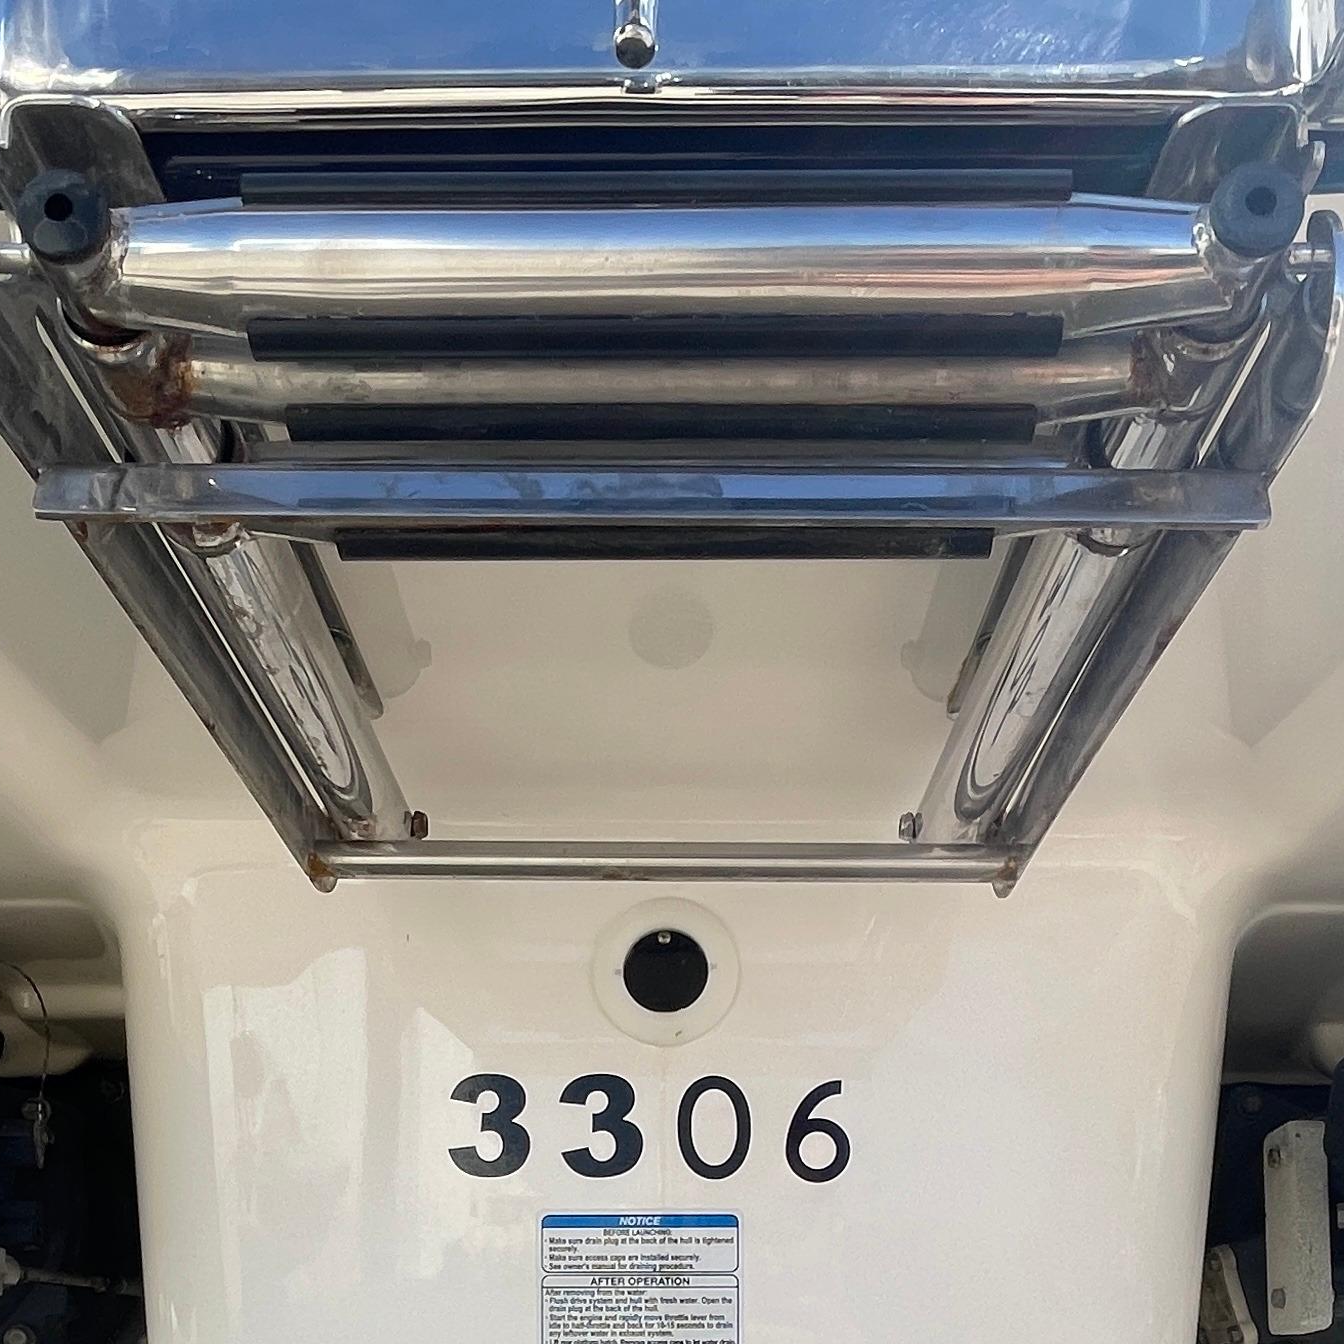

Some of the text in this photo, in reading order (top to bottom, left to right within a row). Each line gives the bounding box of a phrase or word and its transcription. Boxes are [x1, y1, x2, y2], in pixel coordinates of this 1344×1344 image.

[448, 1073, 851, 1183] 3306
[619, 1217, 661, 1226] NOTICE
[702, 1237, 734, 1245] tightened
[629, 1263, 656, 1271] draining
[591, 1277, 690, 1285] AFTER OPERATION
[619, 1314, 642, 1322] rapidly
